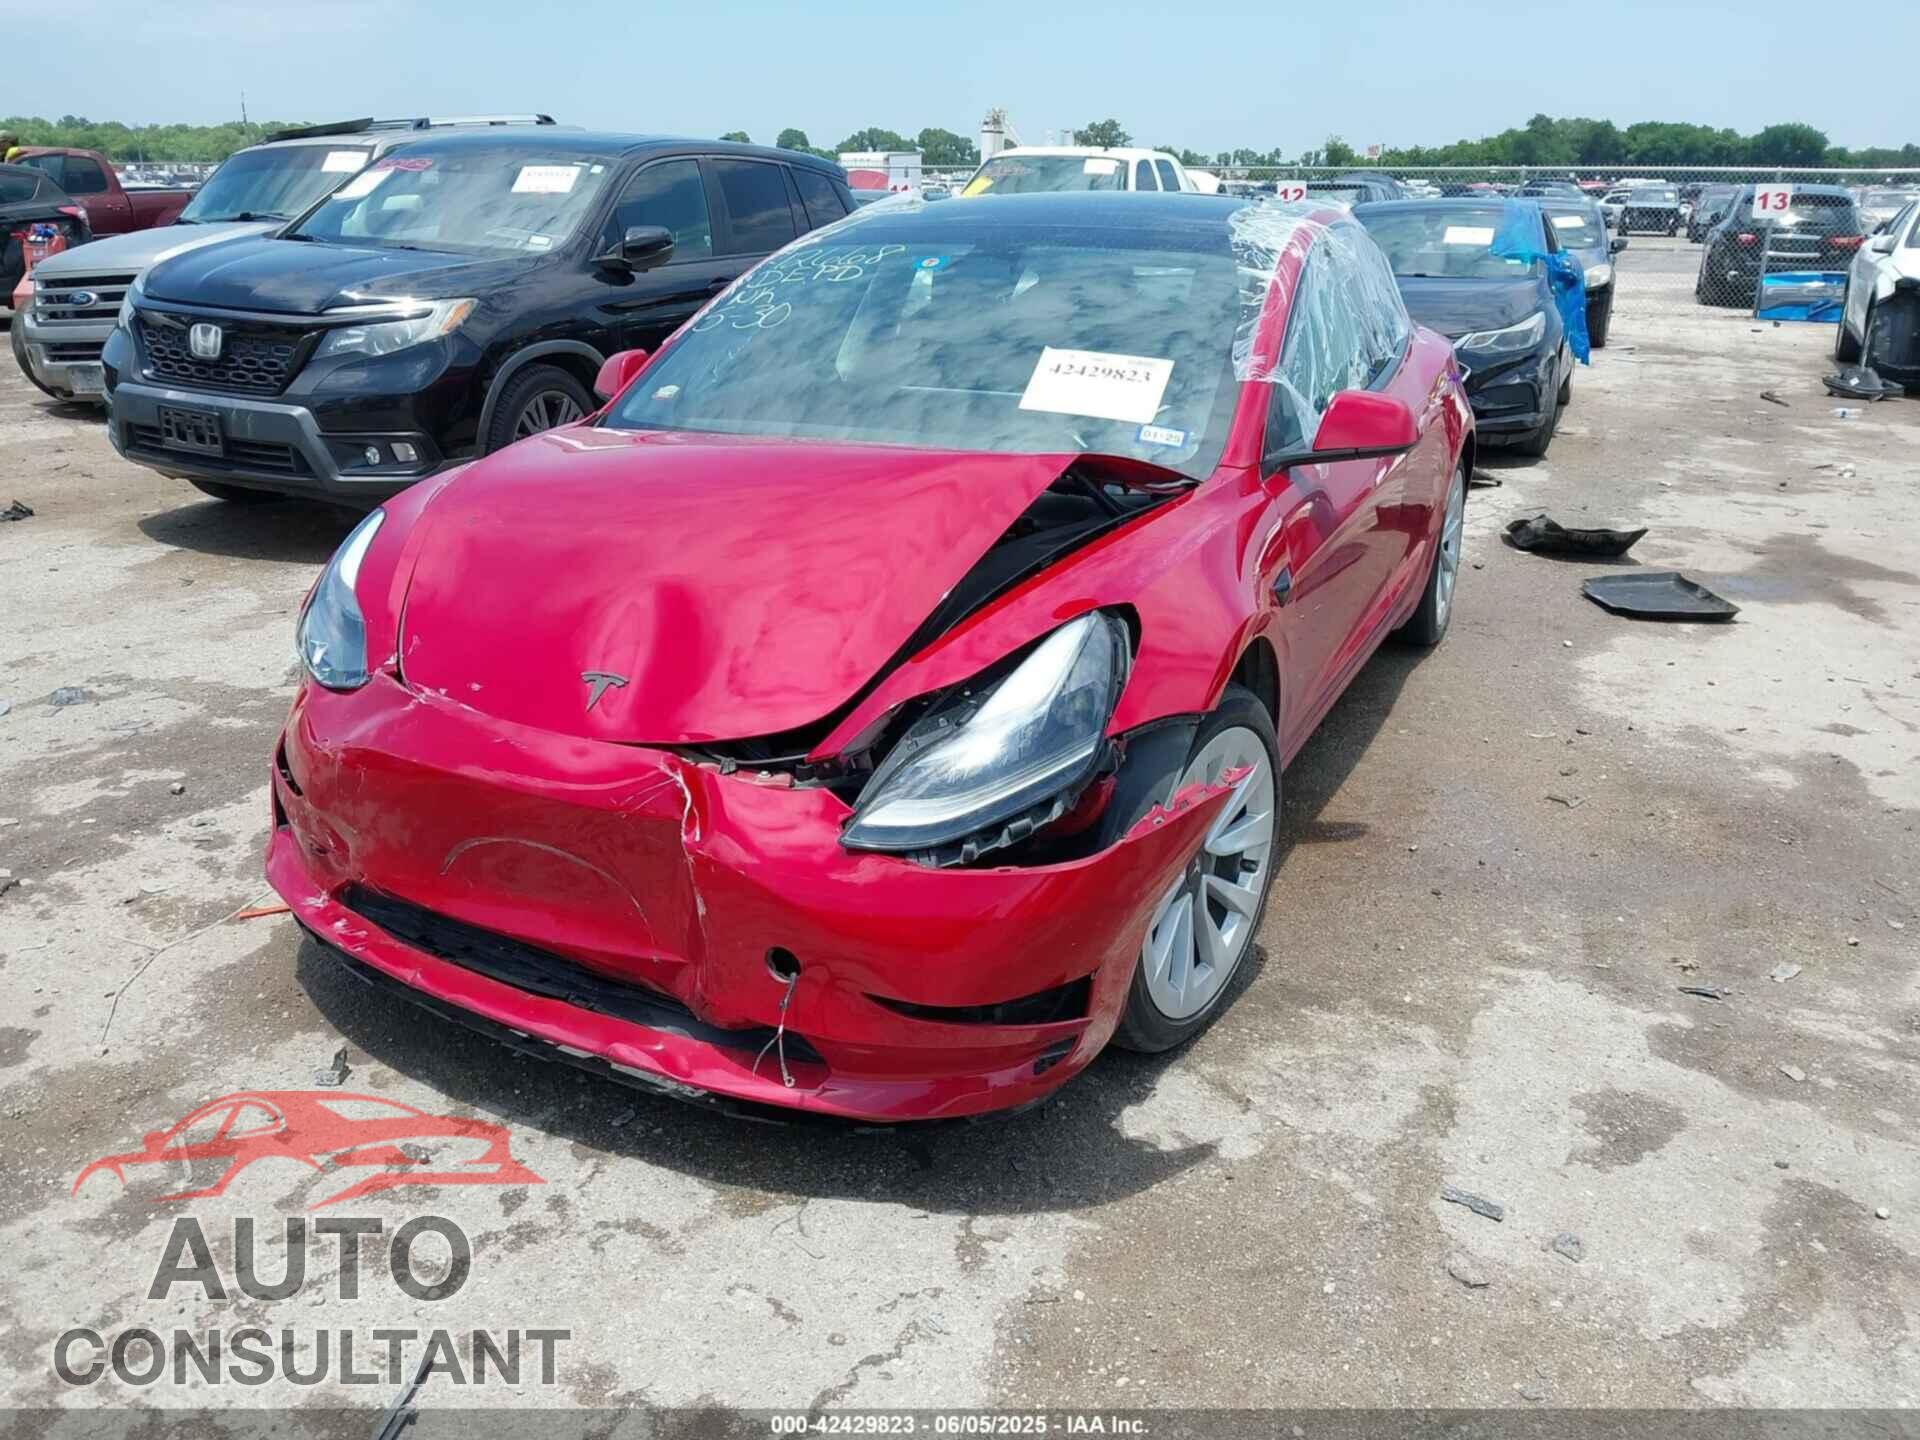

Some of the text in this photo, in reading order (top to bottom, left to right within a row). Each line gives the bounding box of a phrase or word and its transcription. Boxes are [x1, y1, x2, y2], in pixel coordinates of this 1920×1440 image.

[1280, 188, 1304, 202] 12
[1758, 192, 1788, 210] 13
[1049, 362, 1153, 383] 42429823
